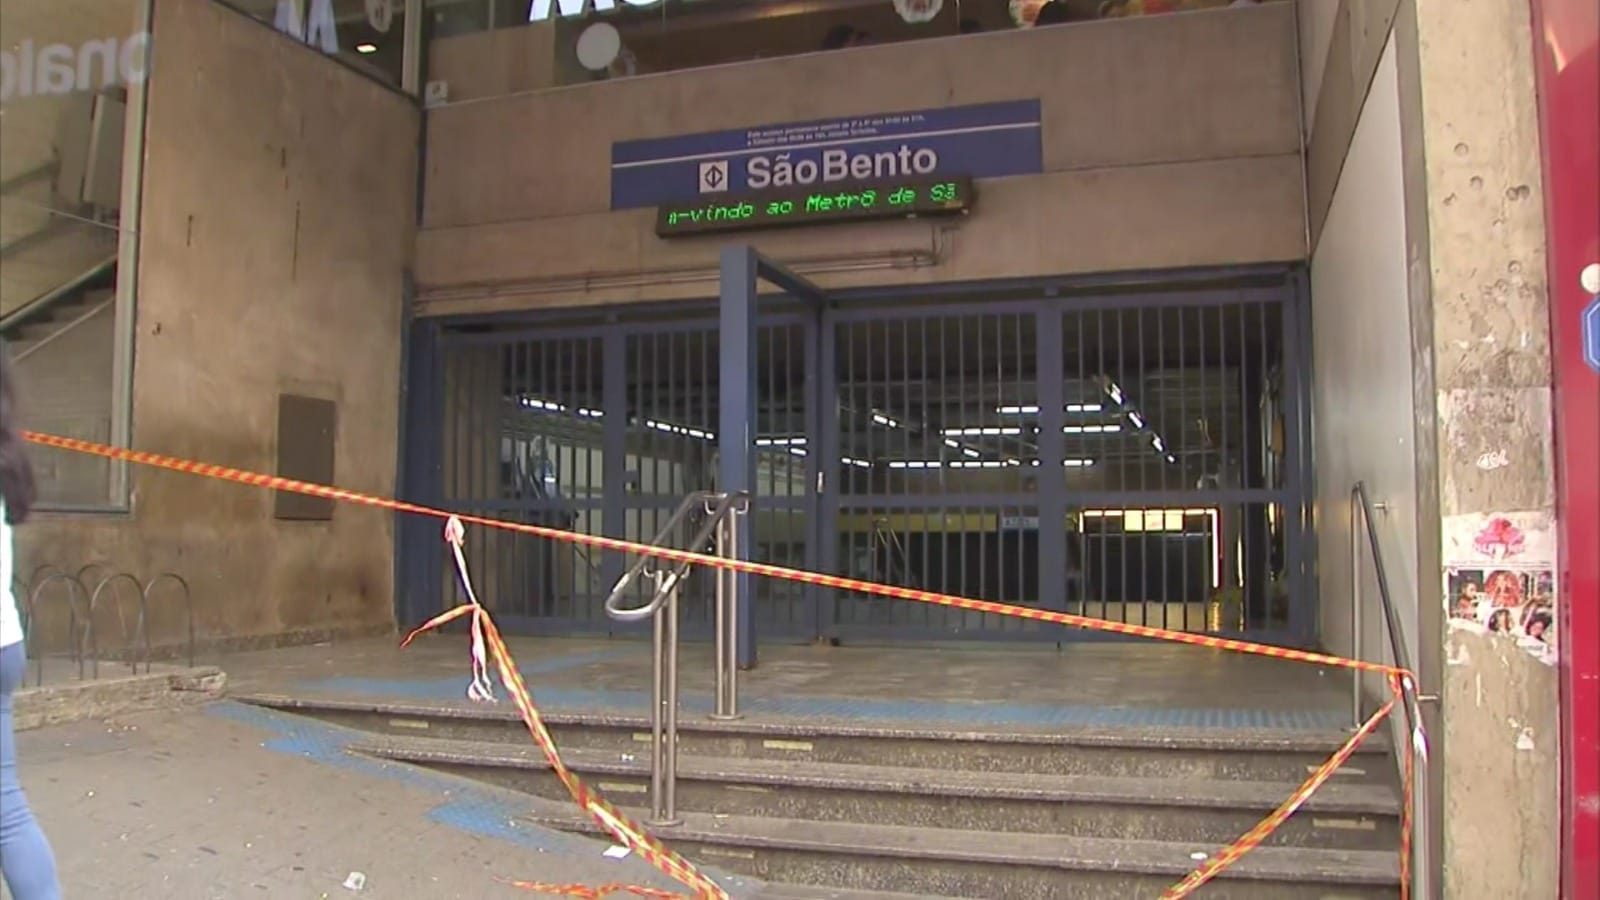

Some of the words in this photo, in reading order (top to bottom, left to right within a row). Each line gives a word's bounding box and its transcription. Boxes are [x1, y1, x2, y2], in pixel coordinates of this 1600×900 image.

[747, 153, 818, 189] São
[823, 145, 938, 182] Bento
[766, 201, 793, 215] ao
[806, 190, 876, 213] Metrô
[888, 187, 915, 204] de
